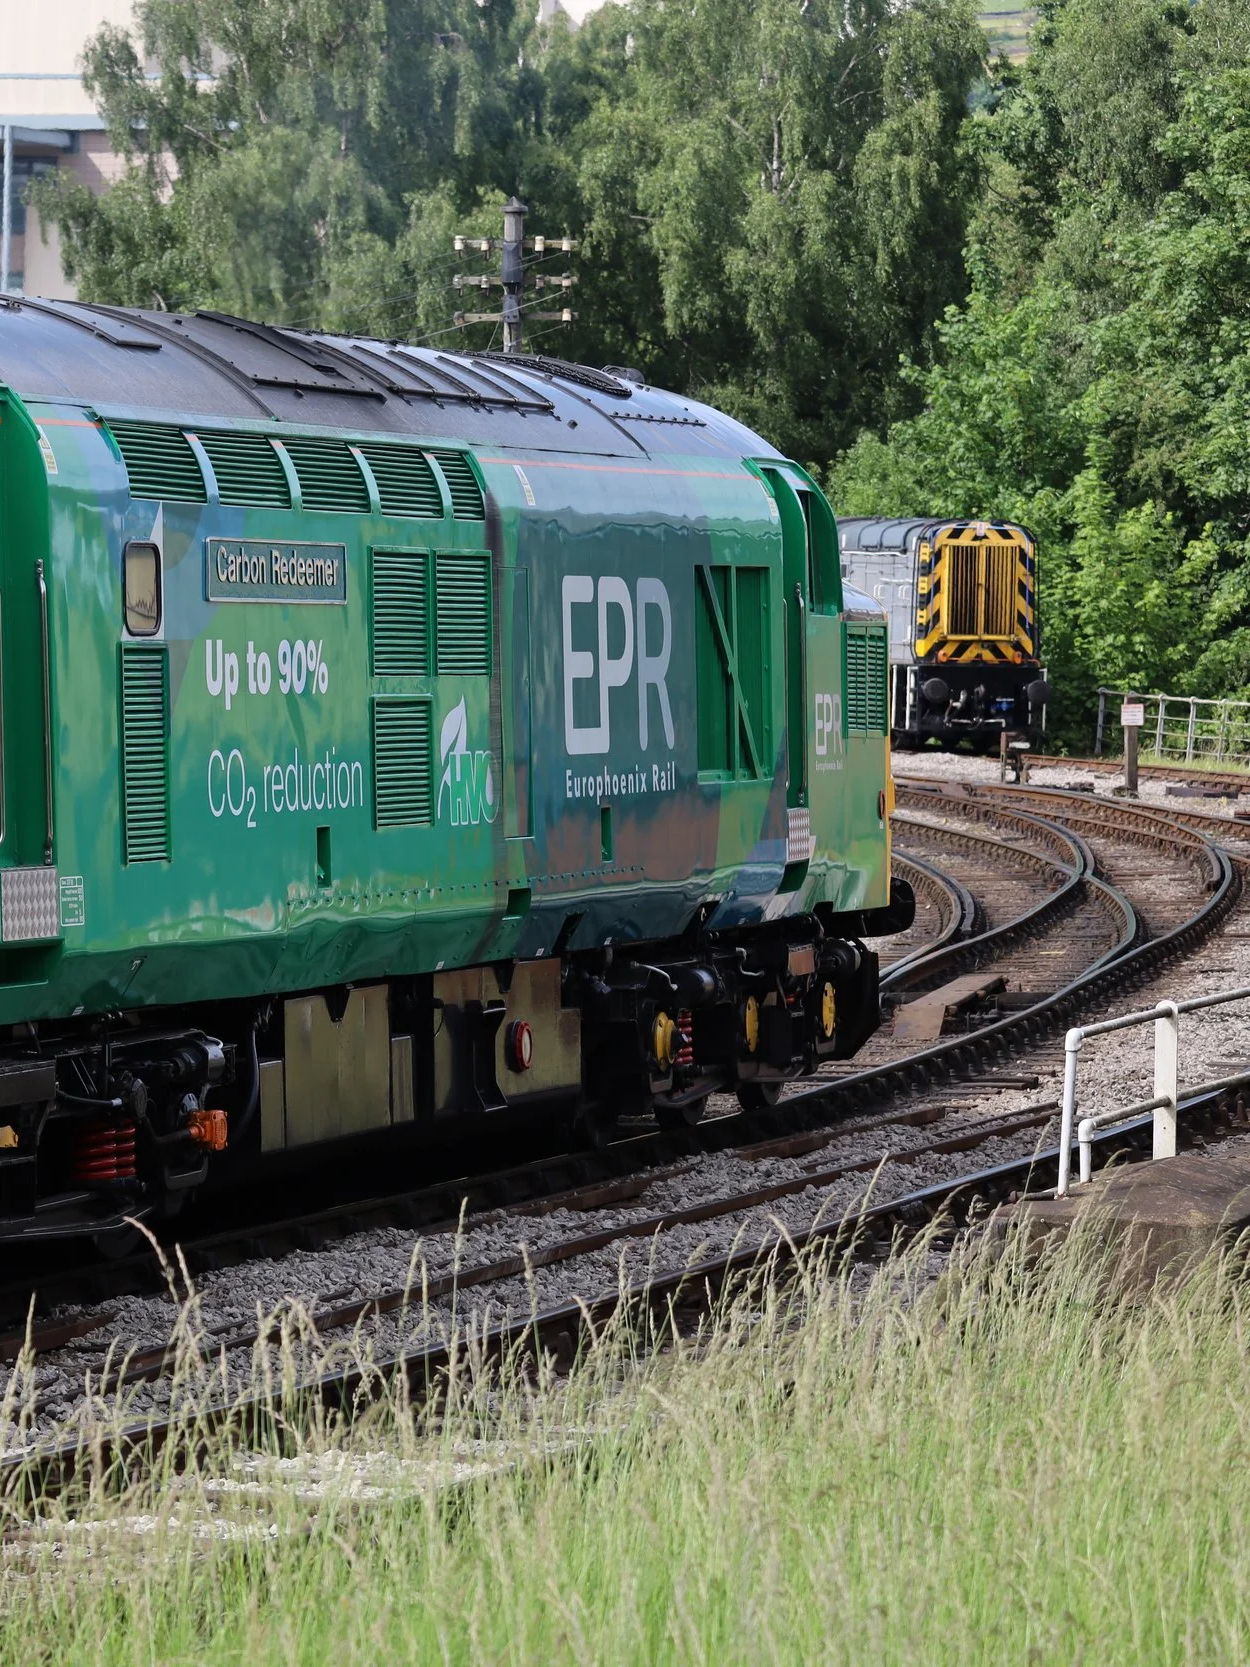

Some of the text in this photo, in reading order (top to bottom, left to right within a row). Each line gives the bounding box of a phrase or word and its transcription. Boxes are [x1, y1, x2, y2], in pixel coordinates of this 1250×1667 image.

[216, 544, 339, 587] Carbon Redeemer
[205, 639, 329, 711] Up to 90%
[561, 575, 675, 755] EPR
[815, 694, 842, 755] EPR
[263, 747, 363, 813] reduction
[449, 750, 499, 826] HVO
[566, 761, 676, 805] Europhoenix Rail
